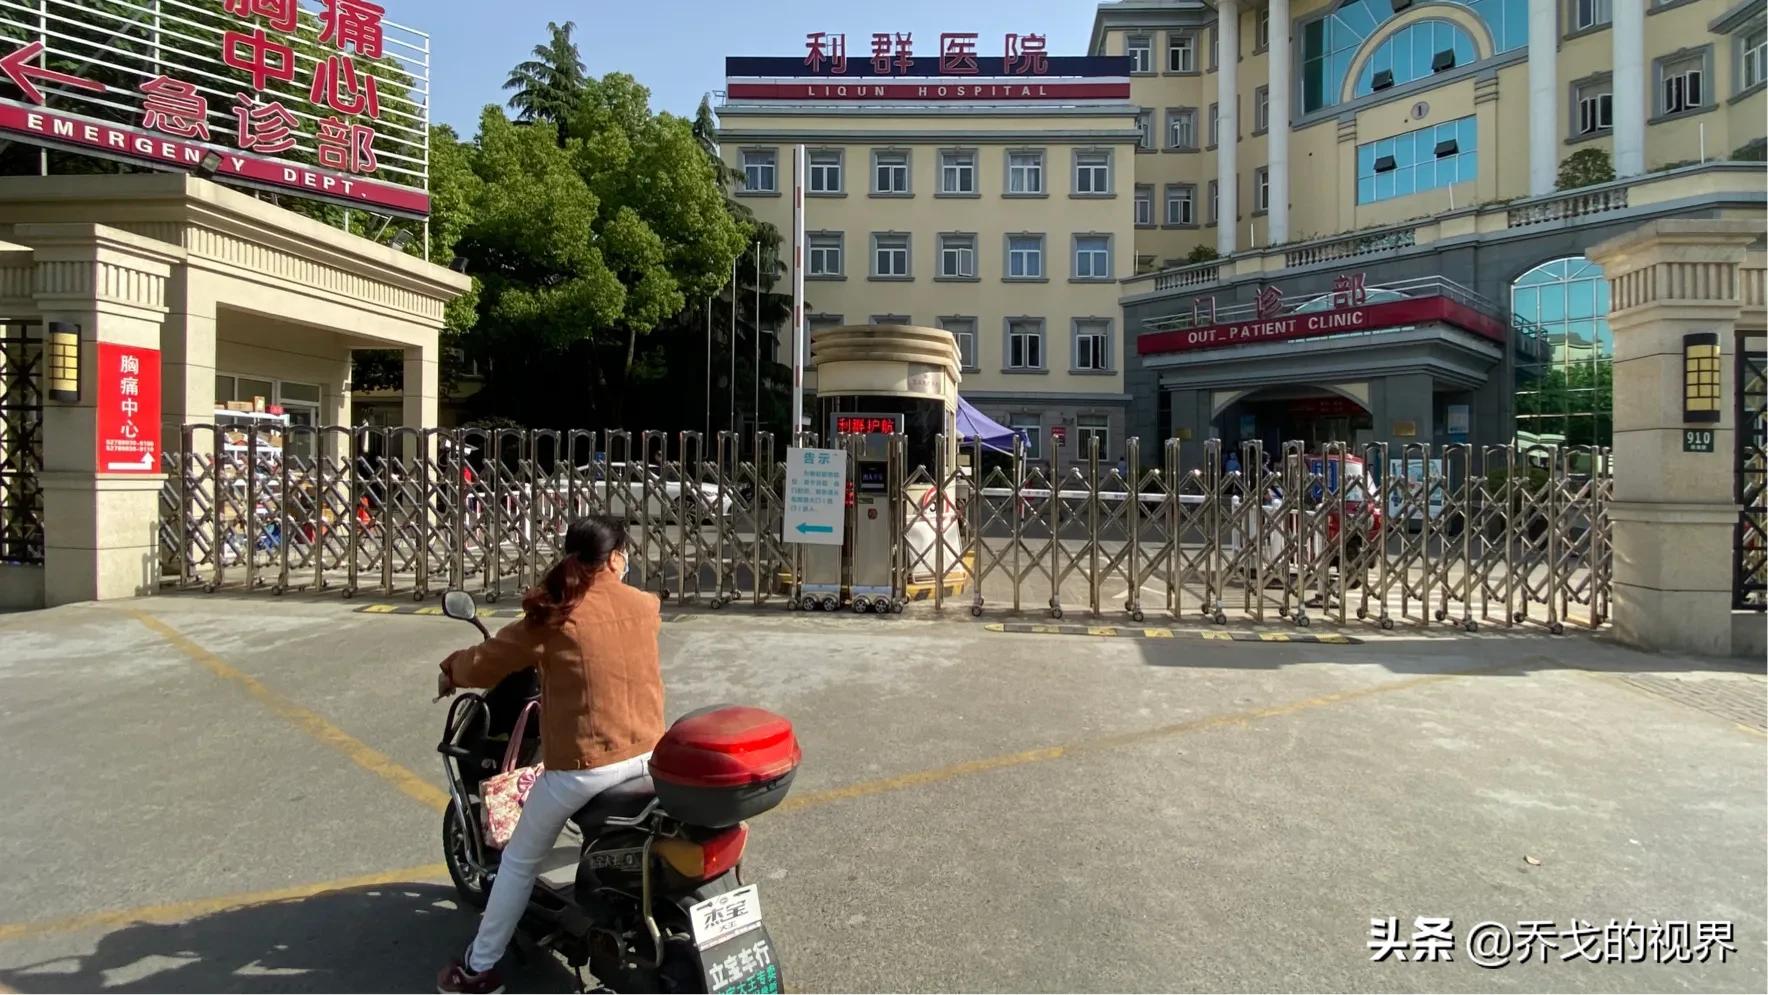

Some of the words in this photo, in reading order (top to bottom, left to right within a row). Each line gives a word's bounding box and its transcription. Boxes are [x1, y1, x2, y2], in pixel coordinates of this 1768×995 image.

[223, 29, 380, 119] 中心
[803, 32, 1049, 75] 利群医院
[808, 86, 886, 97] LIQUN
[918, 85, 1047, 97] HOSPITAL
[27, 113, 245, 173] EMERGENY
[139, 75, 378, 173] 急诊部
[1191, 272, 1366, 326] 门诊部
[1308, 311, 1363, 331] CLINIC
[120, 355, 139, 438] 胸痛中心
[803, 452, 831, 464] 告示
[1687, 431, 1711, 444] 910
[709, 940, 770, 991] 立宝车行
